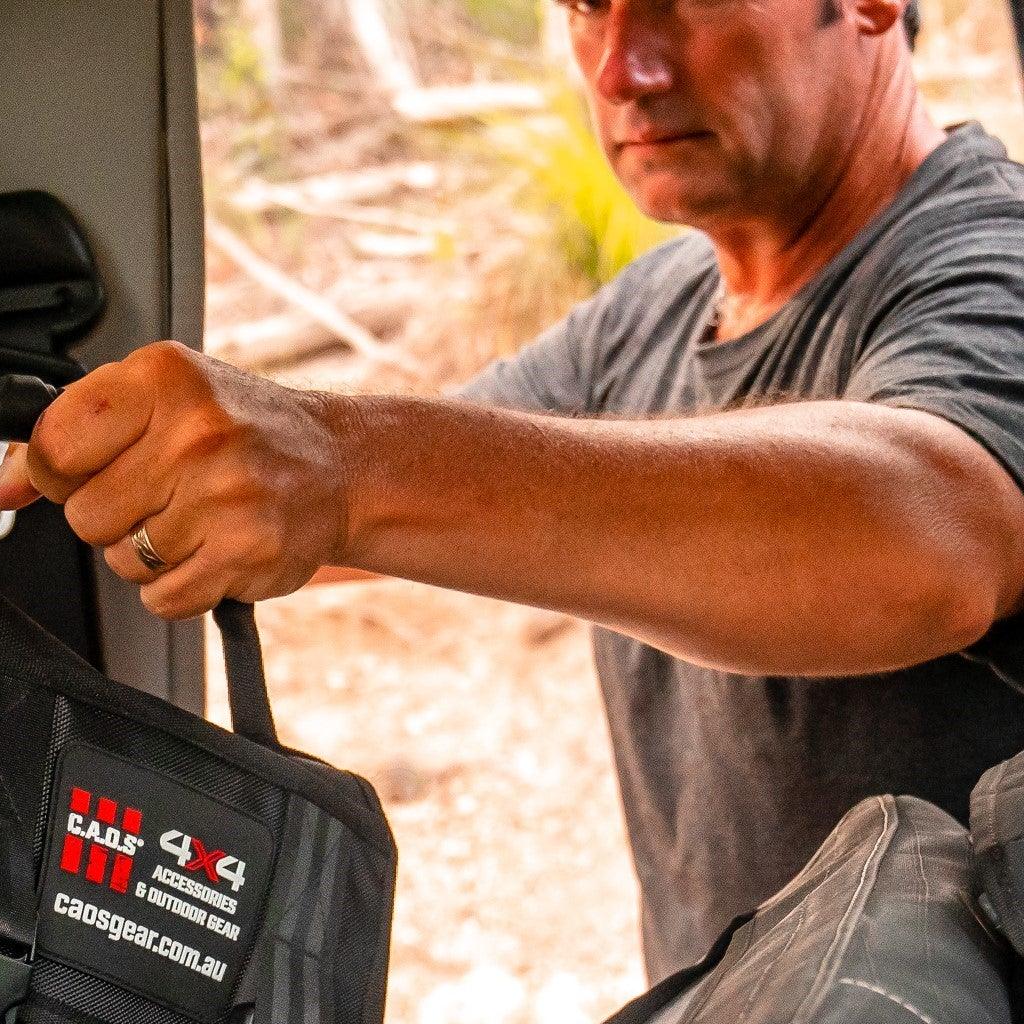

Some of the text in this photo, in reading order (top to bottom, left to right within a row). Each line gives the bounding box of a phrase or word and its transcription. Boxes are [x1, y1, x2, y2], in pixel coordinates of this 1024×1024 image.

[147, 886, 208, 927] OUTDOOR
[206, 913, 241, 942] GEAR
[152, 864, 238, 915] ACCESSORIES
[53, 892, 228, 983] caosgear.com.au
